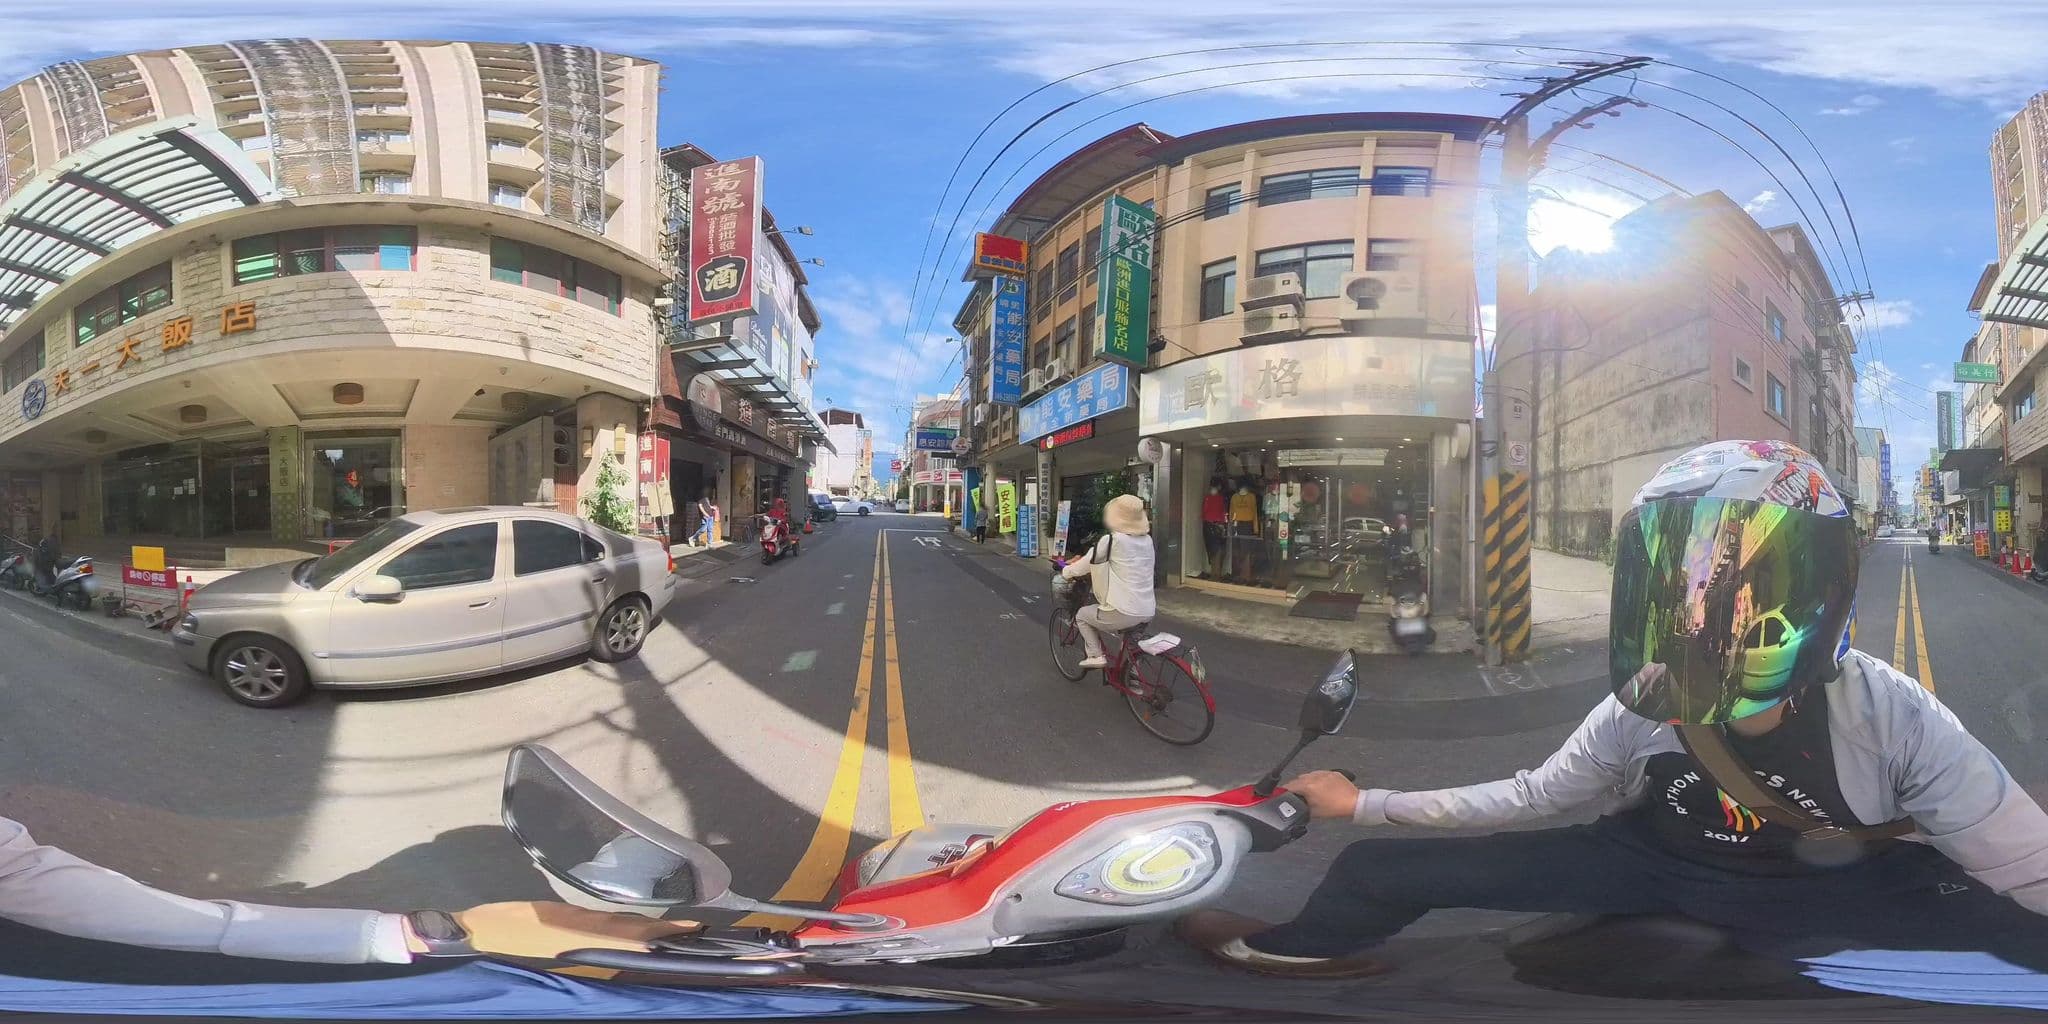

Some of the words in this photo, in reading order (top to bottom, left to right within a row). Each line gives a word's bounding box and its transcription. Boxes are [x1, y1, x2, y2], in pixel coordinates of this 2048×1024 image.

[704, 263, 738, 292] 酒
[1113, 257, 1132, 352] 歐洲進口服飾名店
[54, 301, 257, 396] 天一大飯店
